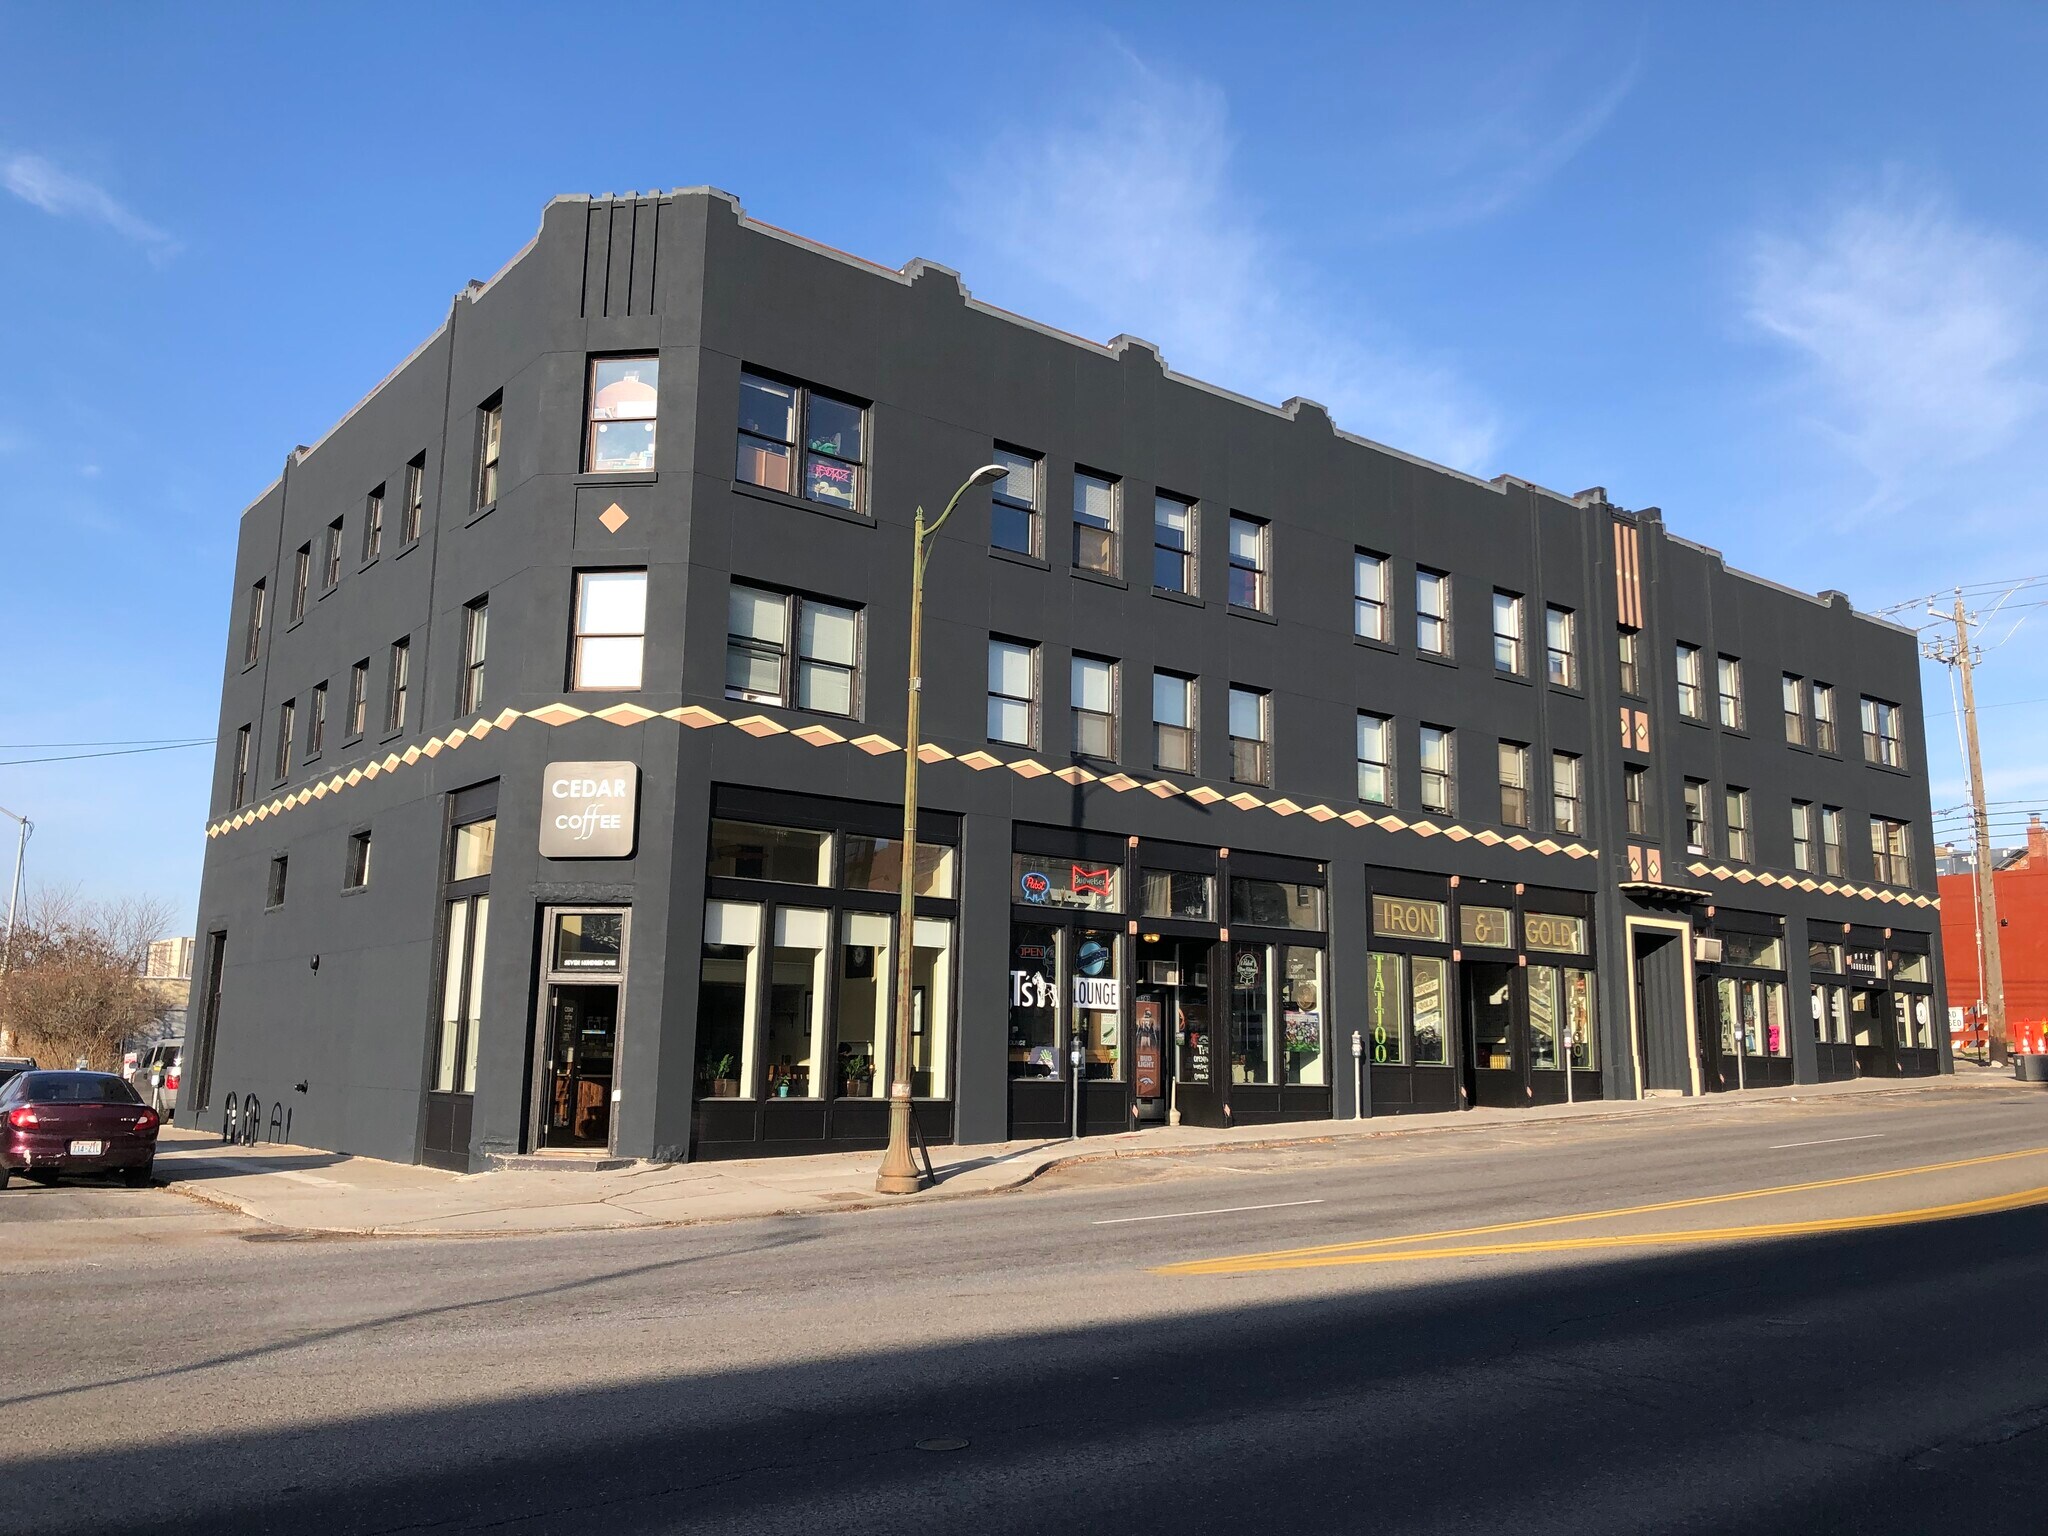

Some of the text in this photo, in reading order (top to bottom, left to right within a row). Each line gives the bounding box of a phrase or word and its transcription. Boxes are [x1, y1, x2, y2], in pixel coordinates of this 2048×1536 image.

[552, 779, 626, 799] CEDAR
[1383, 902, 1571, 946] IRON & GOLD
[1074, 981, 1116, 1006] LOUNGE
[1372, 954, 1387, 1063] TATTOO
